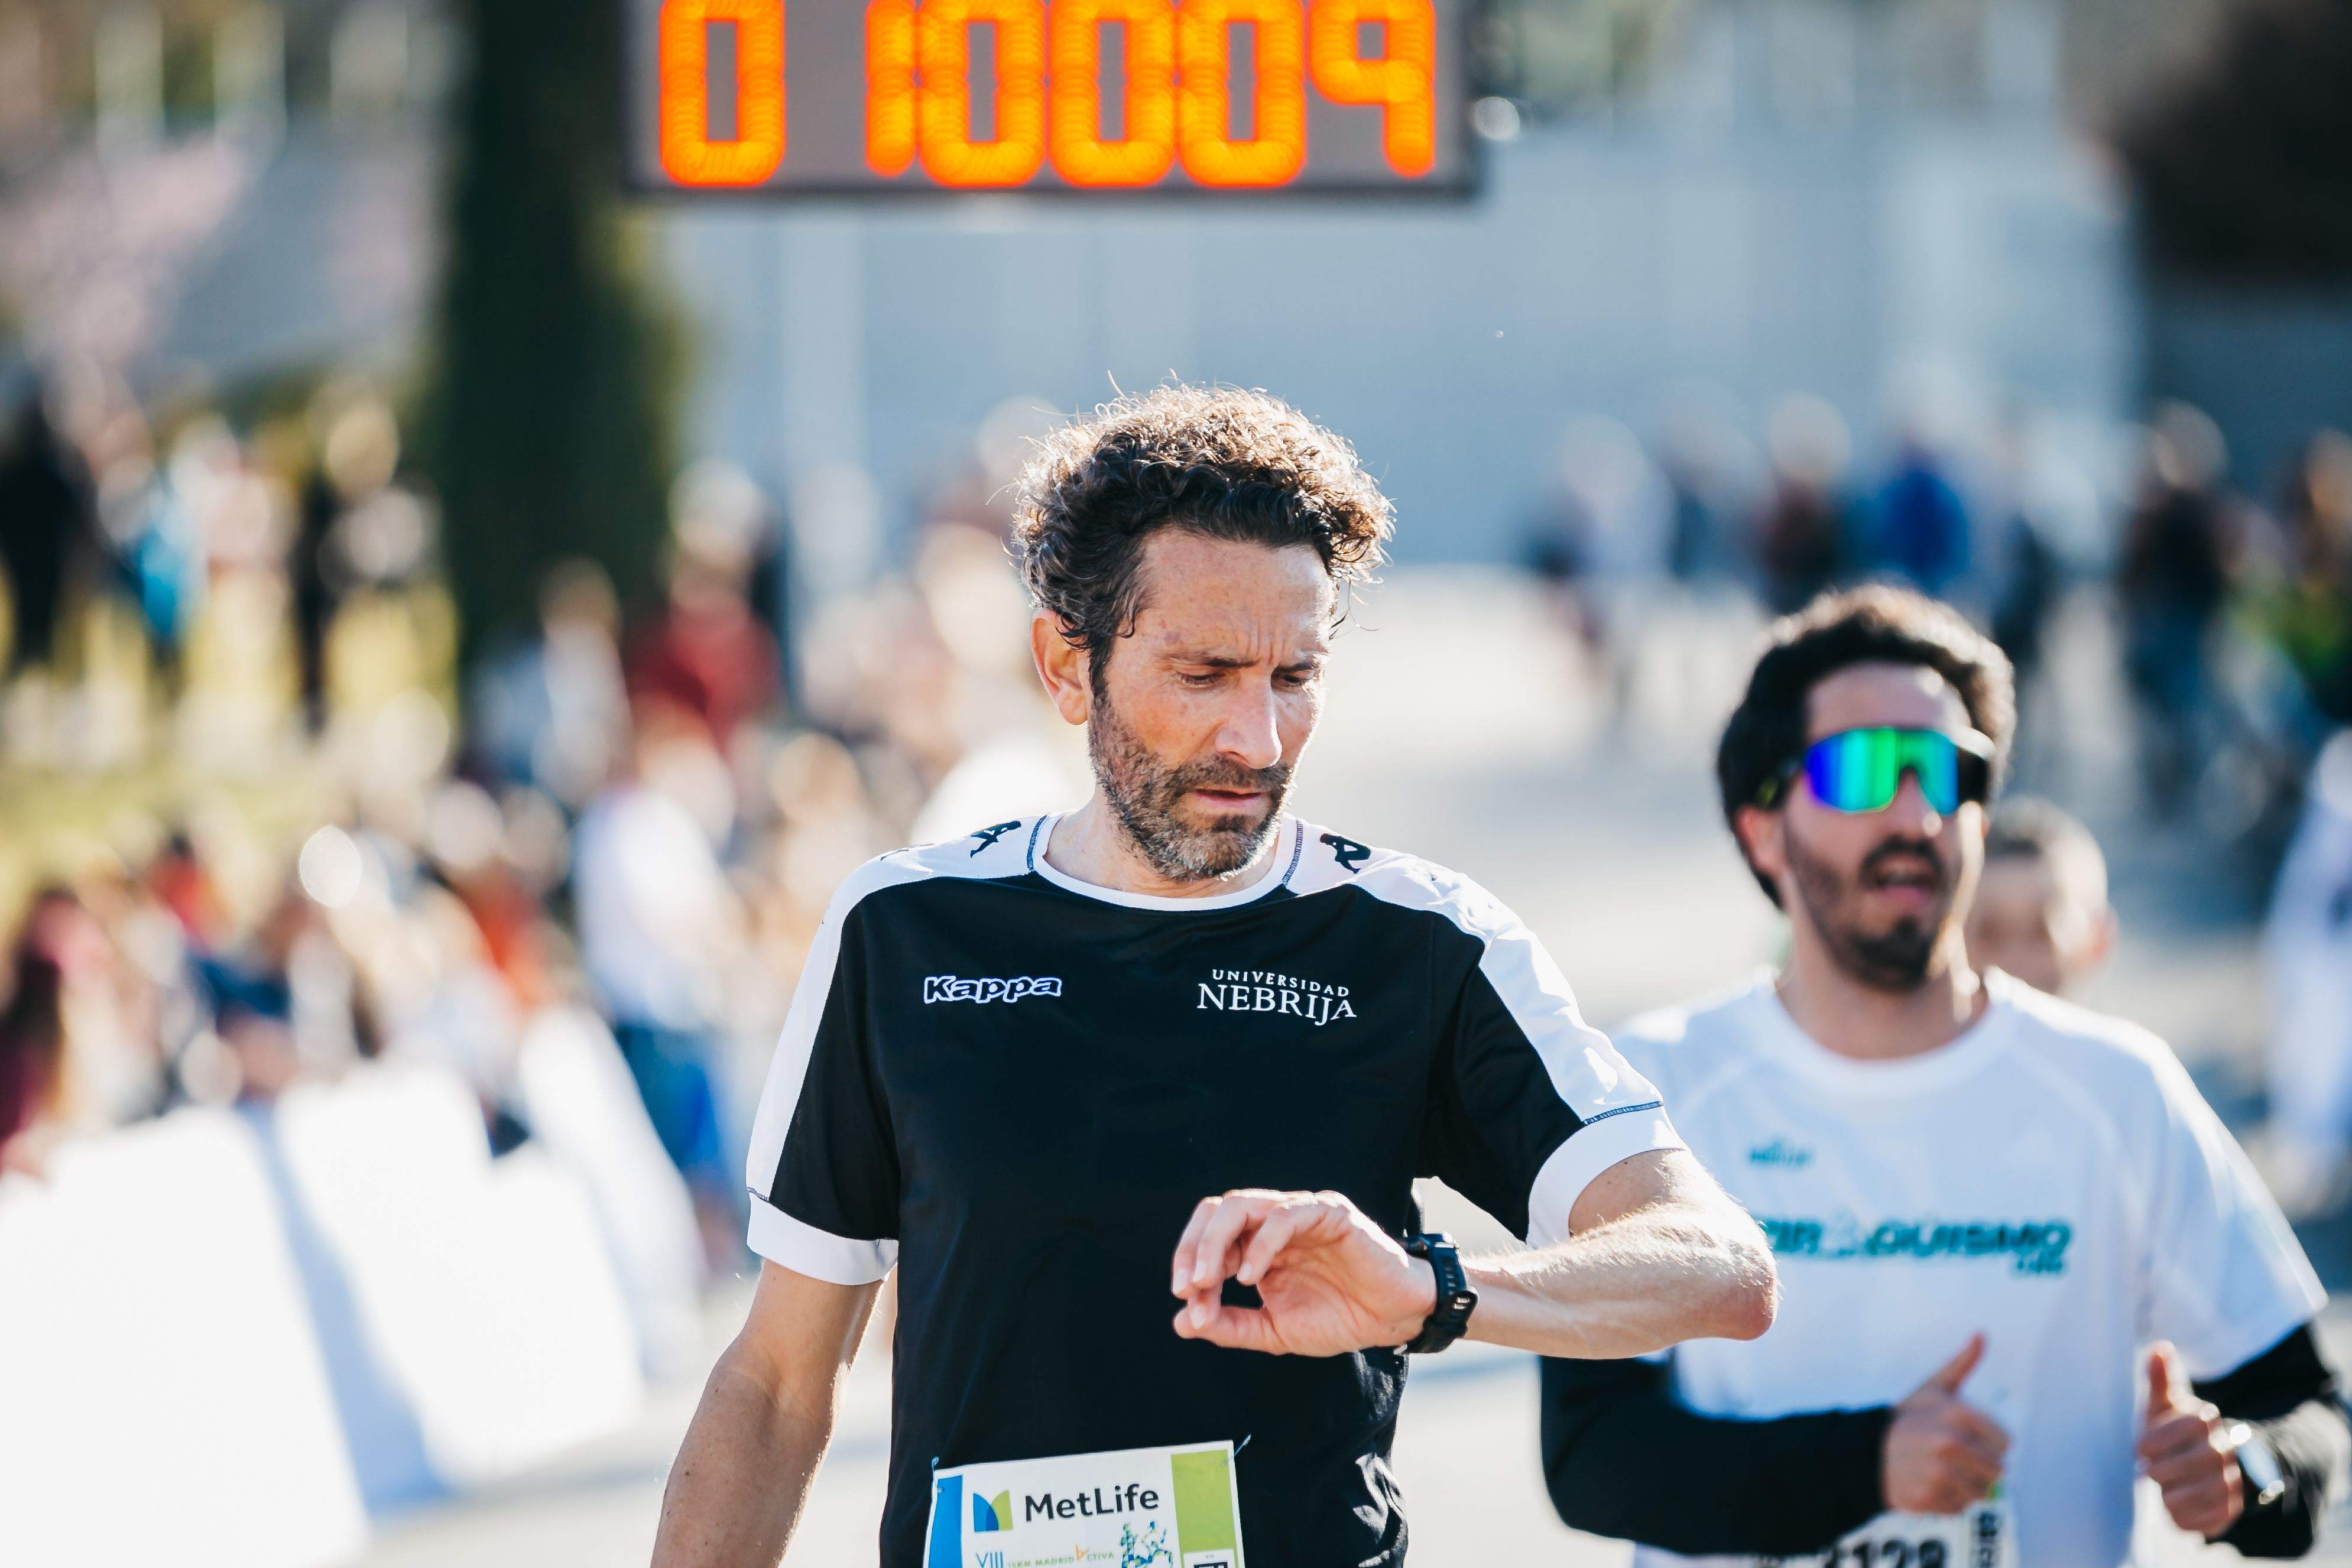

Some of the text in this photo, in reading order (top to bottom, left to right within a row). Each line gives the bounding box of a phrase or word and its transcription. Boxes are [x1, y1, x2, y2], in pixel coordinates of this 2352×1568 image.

[923, 975, 1062, 1004] Kappa
[1212, 969, 1350, 998] UNIVERSIDAD
[1197, 982, 1357, 1026] NEBRIJA
[1025, 1483, 1159, 1523] MetLife
[975, 1551, 1004, 1568] VIII
[1035, 1556, 1074, 1567] MADRID
